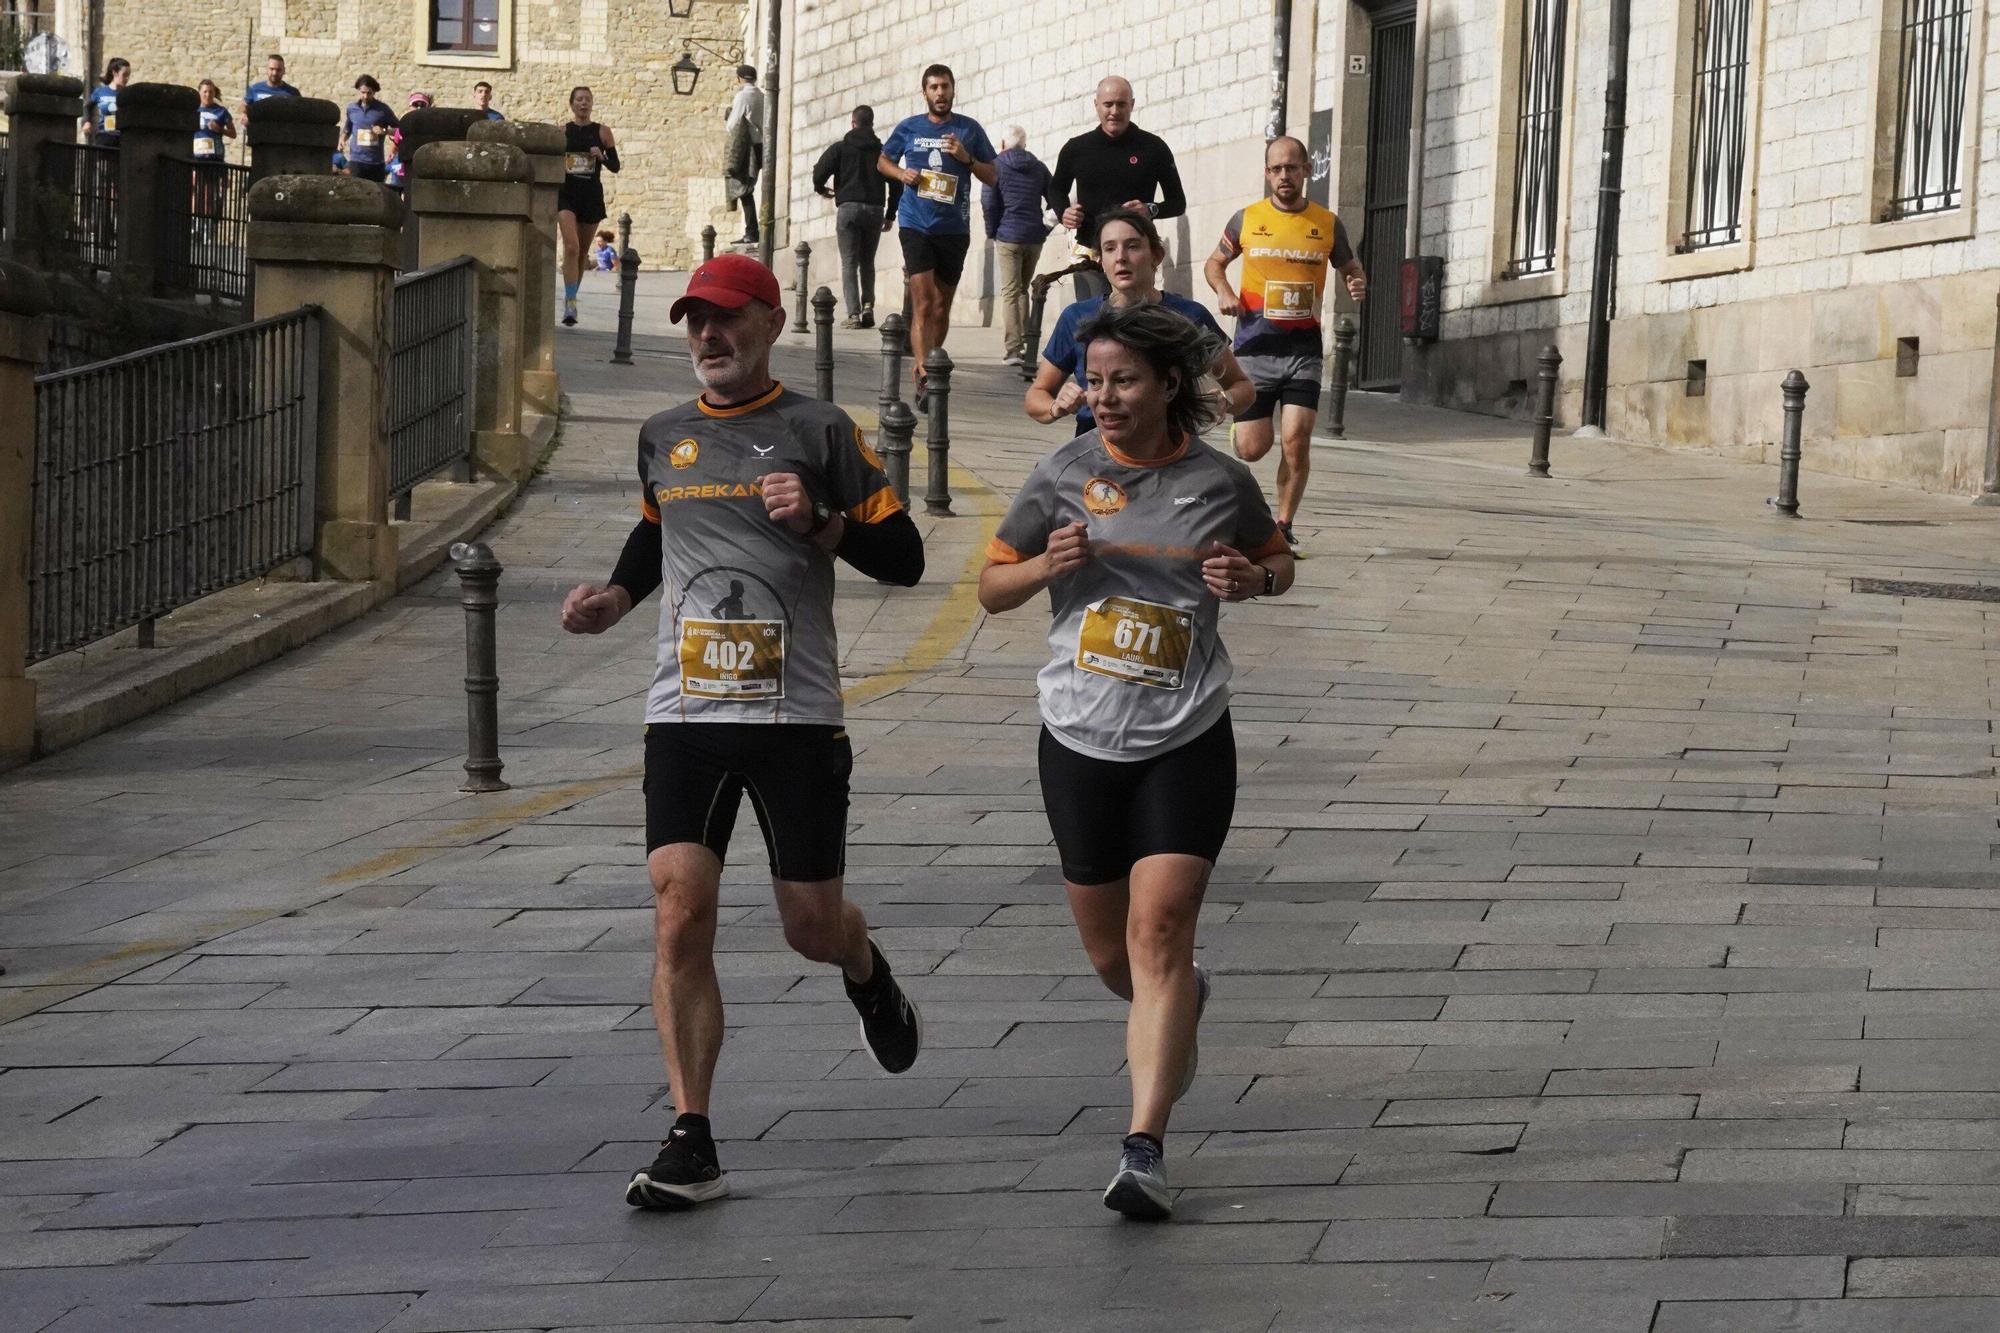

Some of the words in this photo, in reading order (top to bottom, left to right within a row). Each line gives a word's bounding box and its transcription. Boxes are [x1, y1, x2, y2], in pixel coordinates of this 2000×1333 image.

[1249, 247, 1324, 260] GRANUJA
[1283, 291, 1300, 306] 84
[763, 628, 777, 637] 10K
[1113, 618, 1162, 655] 671
[703, 640, 755, 671] 402
[1121, 652, 1145, 664] LAURA
[719, 671, 738, 681] IÑIGO
